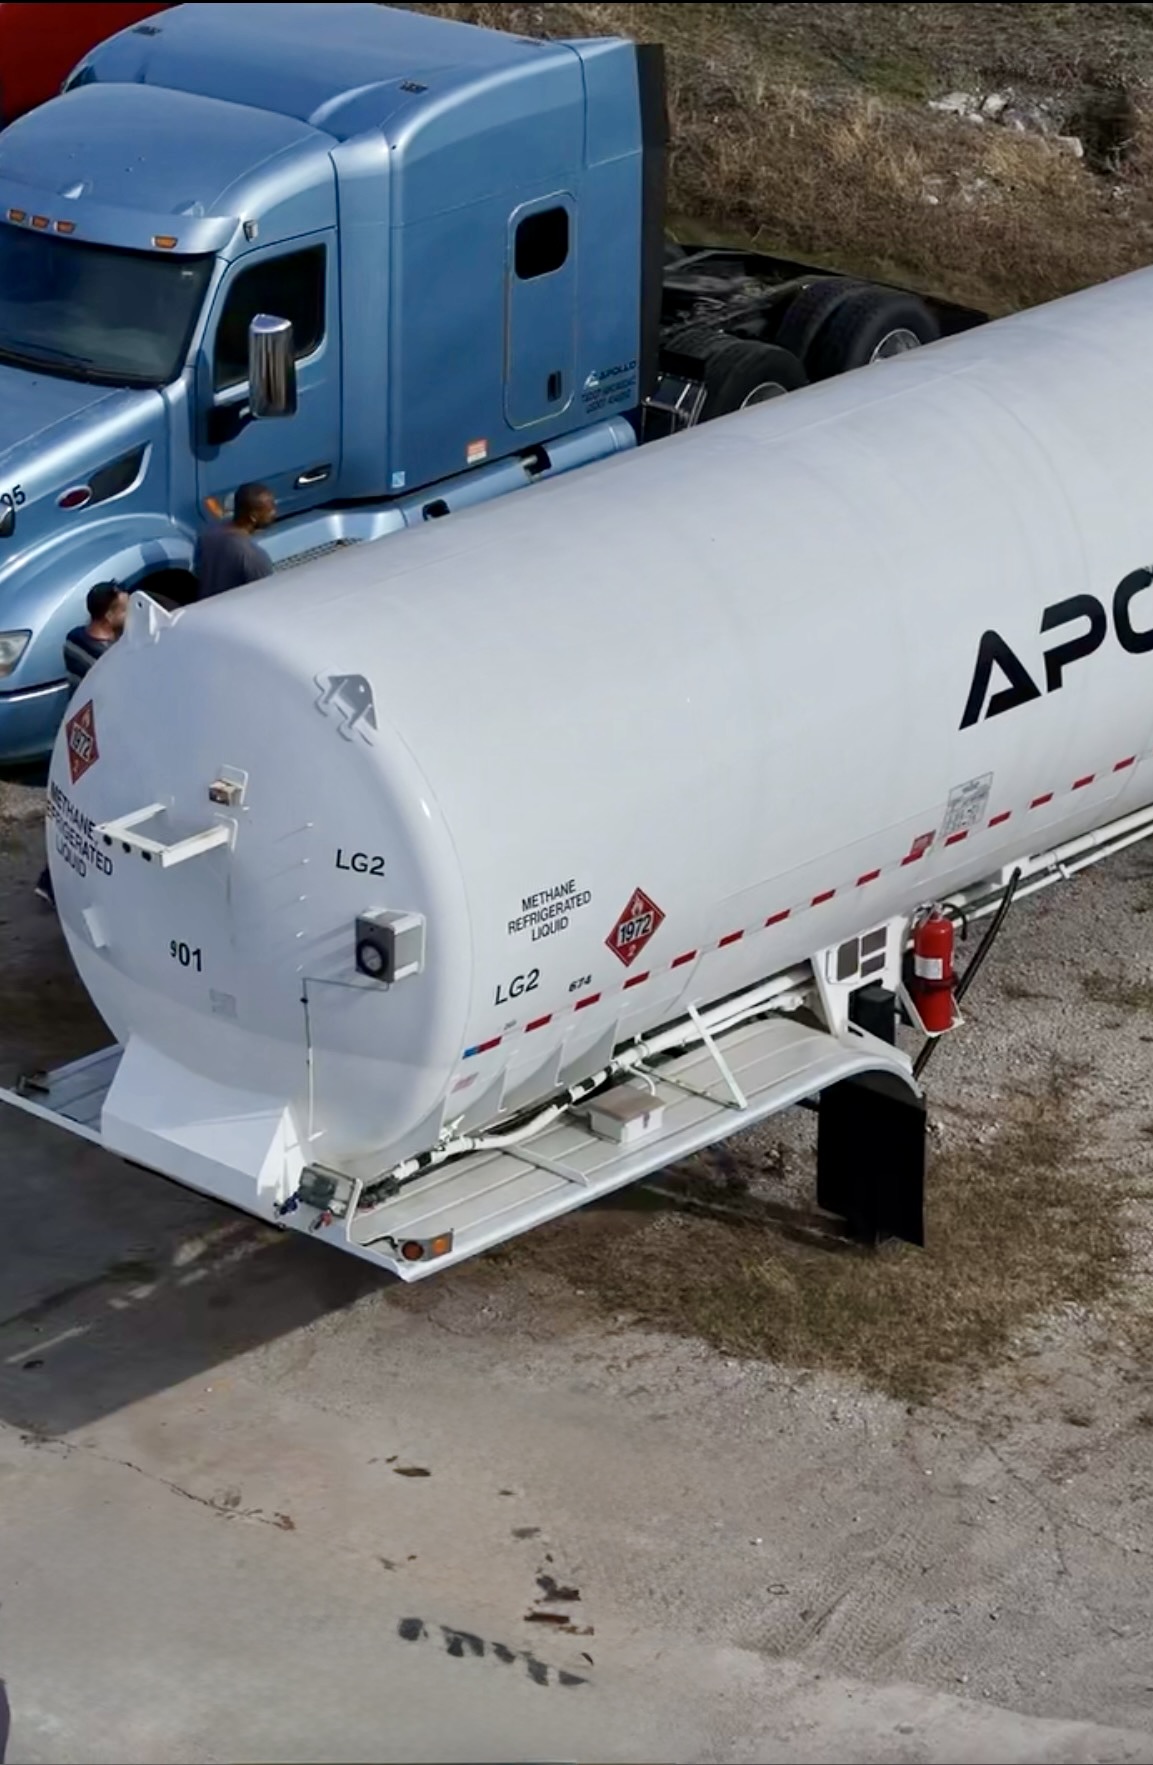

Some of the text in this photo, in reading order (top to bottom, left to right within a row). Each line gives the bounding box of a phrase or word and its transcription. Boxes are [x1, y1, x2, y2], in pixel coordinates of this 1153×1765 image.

[335, 848, 386, 877] LG2
[521, 878, 577, 912] METHANE
[507, 889, 592, 935] REFRIGERATED
[531, 915, 569, 942] LIQUID
[620, 913, 652, 944] 1972
[494, 967, 541, 1006] LG2
